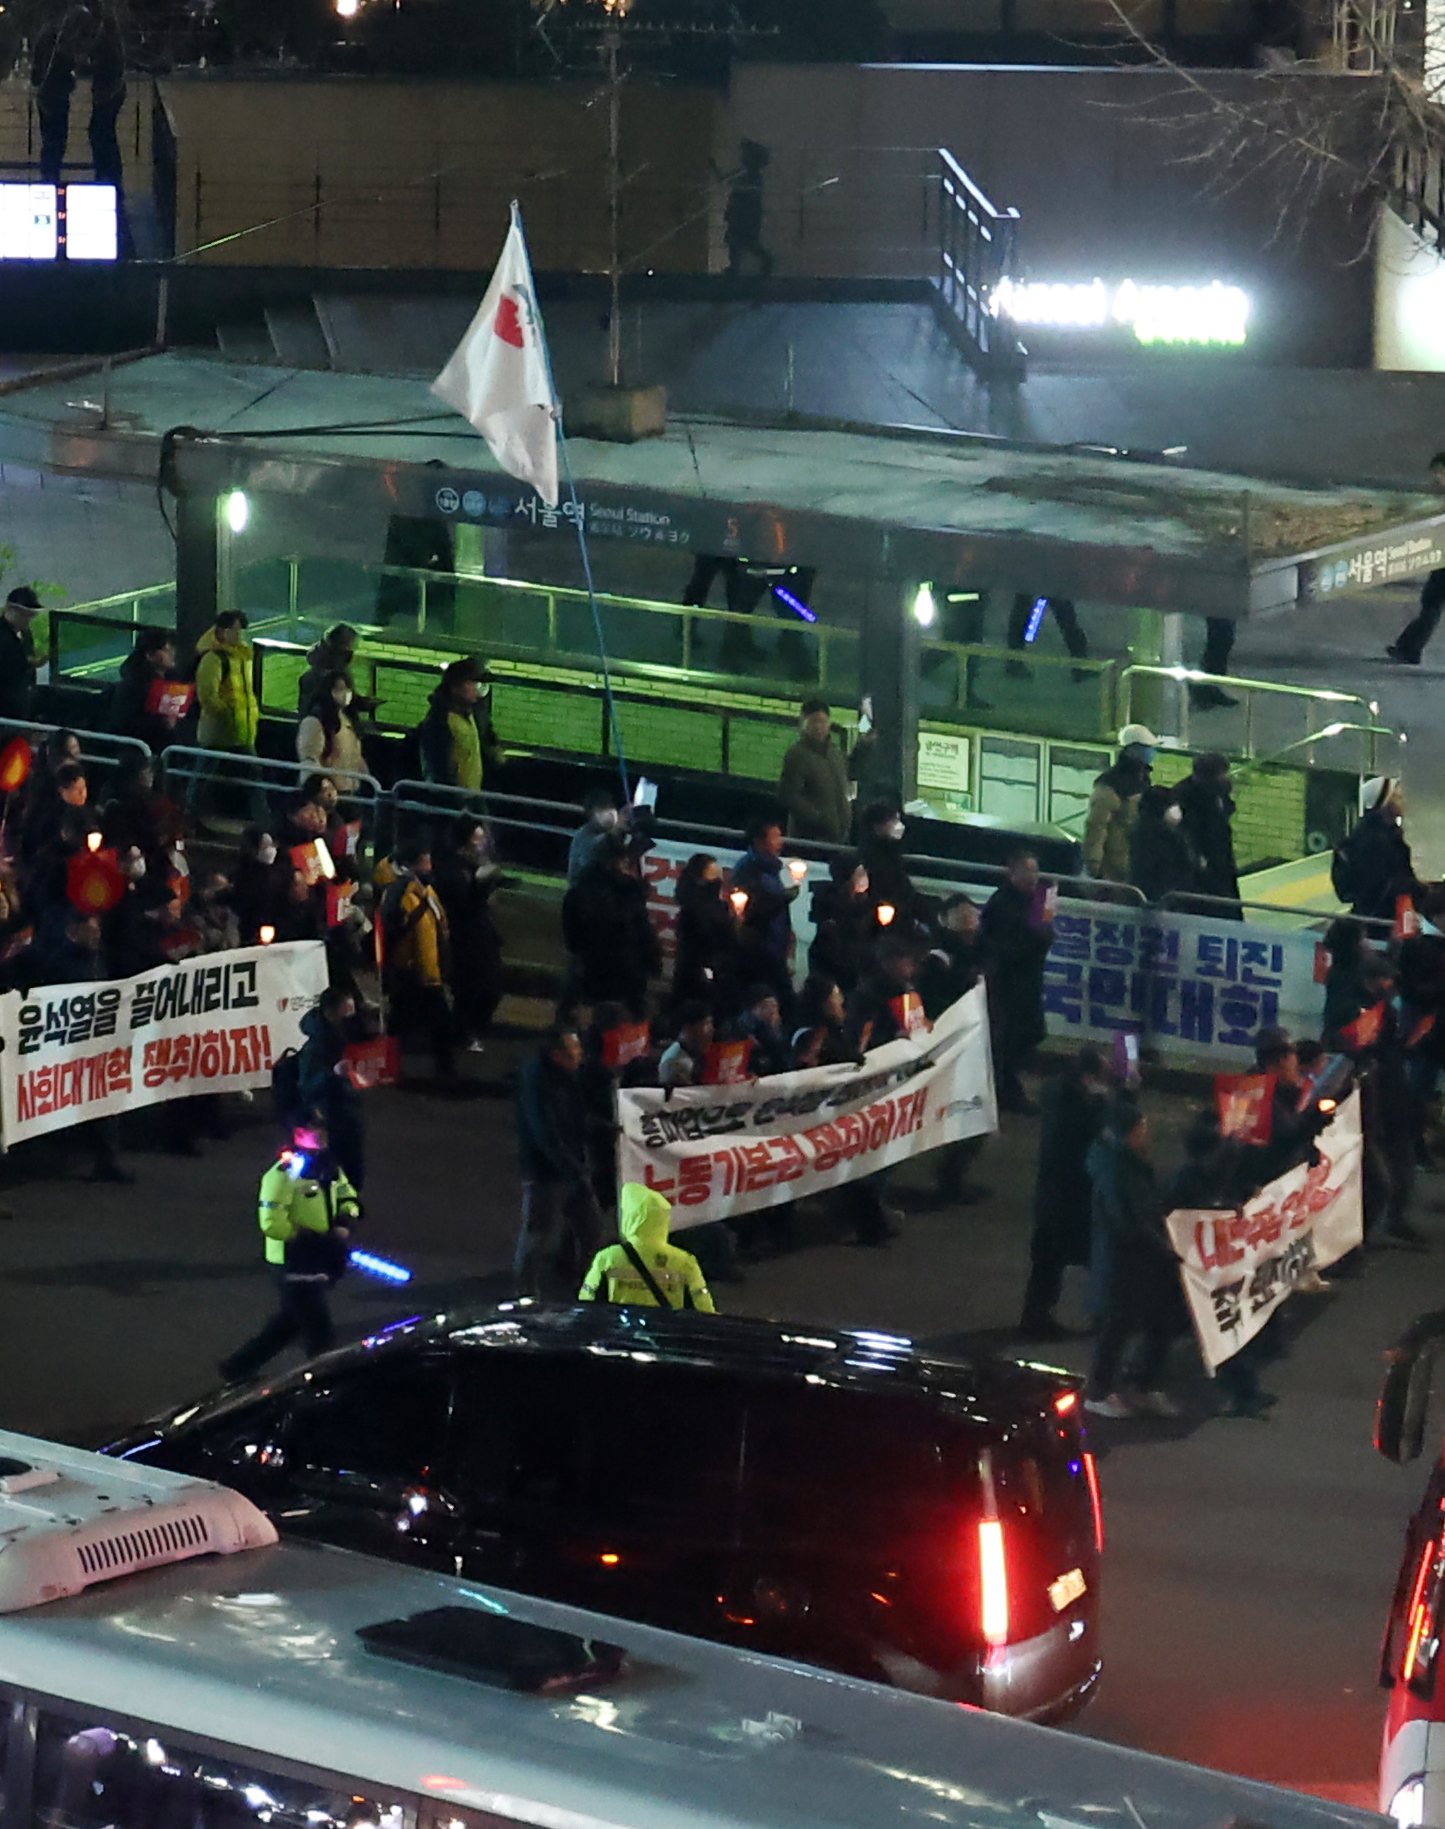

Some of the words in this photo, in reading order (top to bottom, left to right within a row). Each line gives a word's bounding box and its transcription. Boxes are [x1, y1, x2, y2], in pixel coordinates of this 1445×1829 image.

[515, 495, 585, 532] 서울역
[1348, 547, 1387, 583] 서울역
[1196, 933, 1285, 988] 퇴진
[18, 987, 121, 1056] 윤석열을
[16, 1051, 133, 1123] 사회대개혁
[140, 1025, 273, 1090] 쟁취하자!
